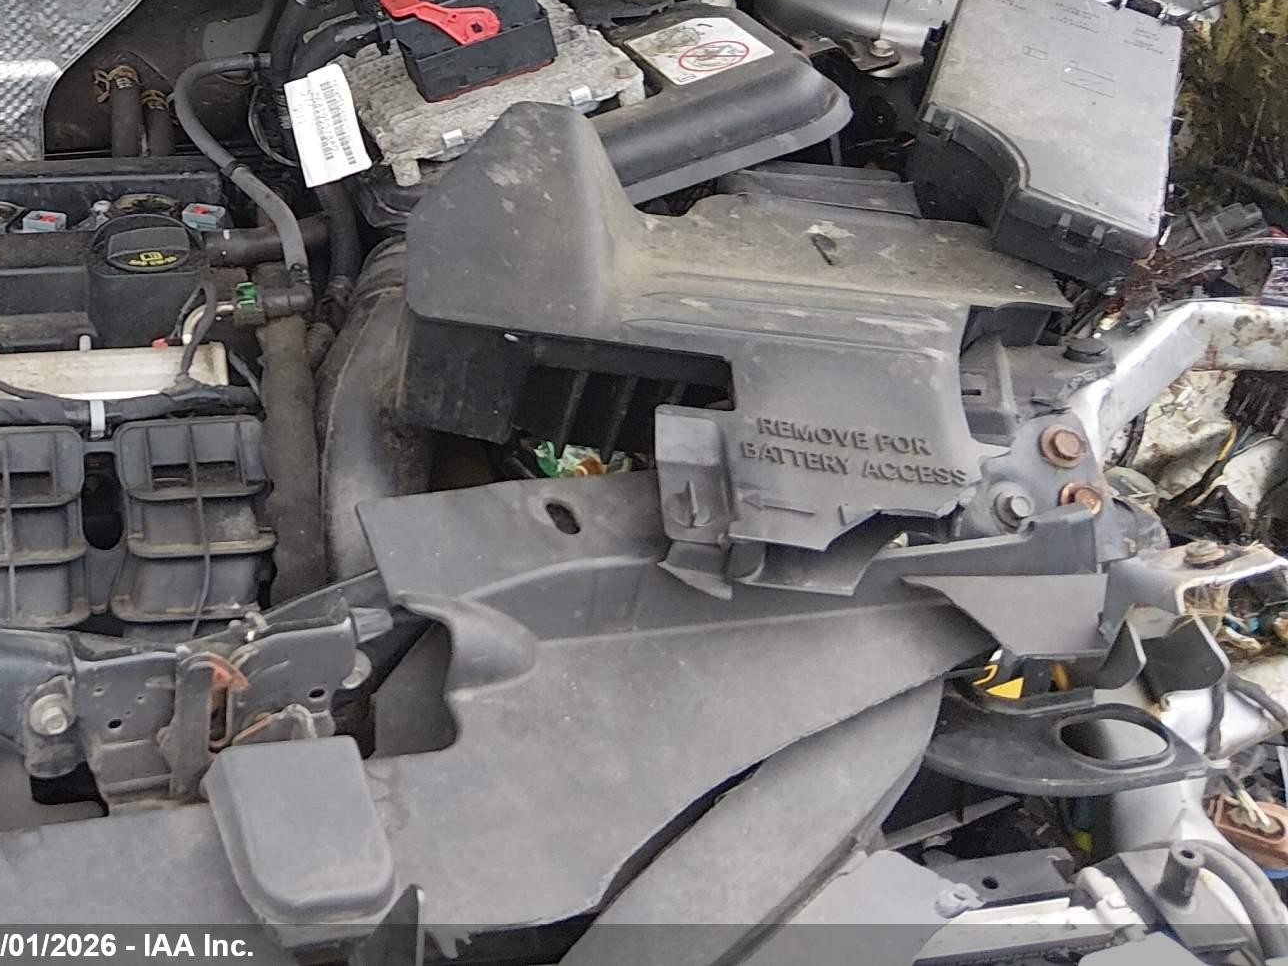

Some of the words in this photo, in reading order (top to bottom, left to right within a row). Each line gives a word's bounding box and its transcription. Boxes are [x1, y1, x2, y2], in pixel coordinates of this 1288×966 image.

[756, 417, 869, 453] REMOVE
[877, 433, 932, 457] FOR
[740, 441, 850, 476] BATTERY
[861, 460, 968, 487] ACCESS
